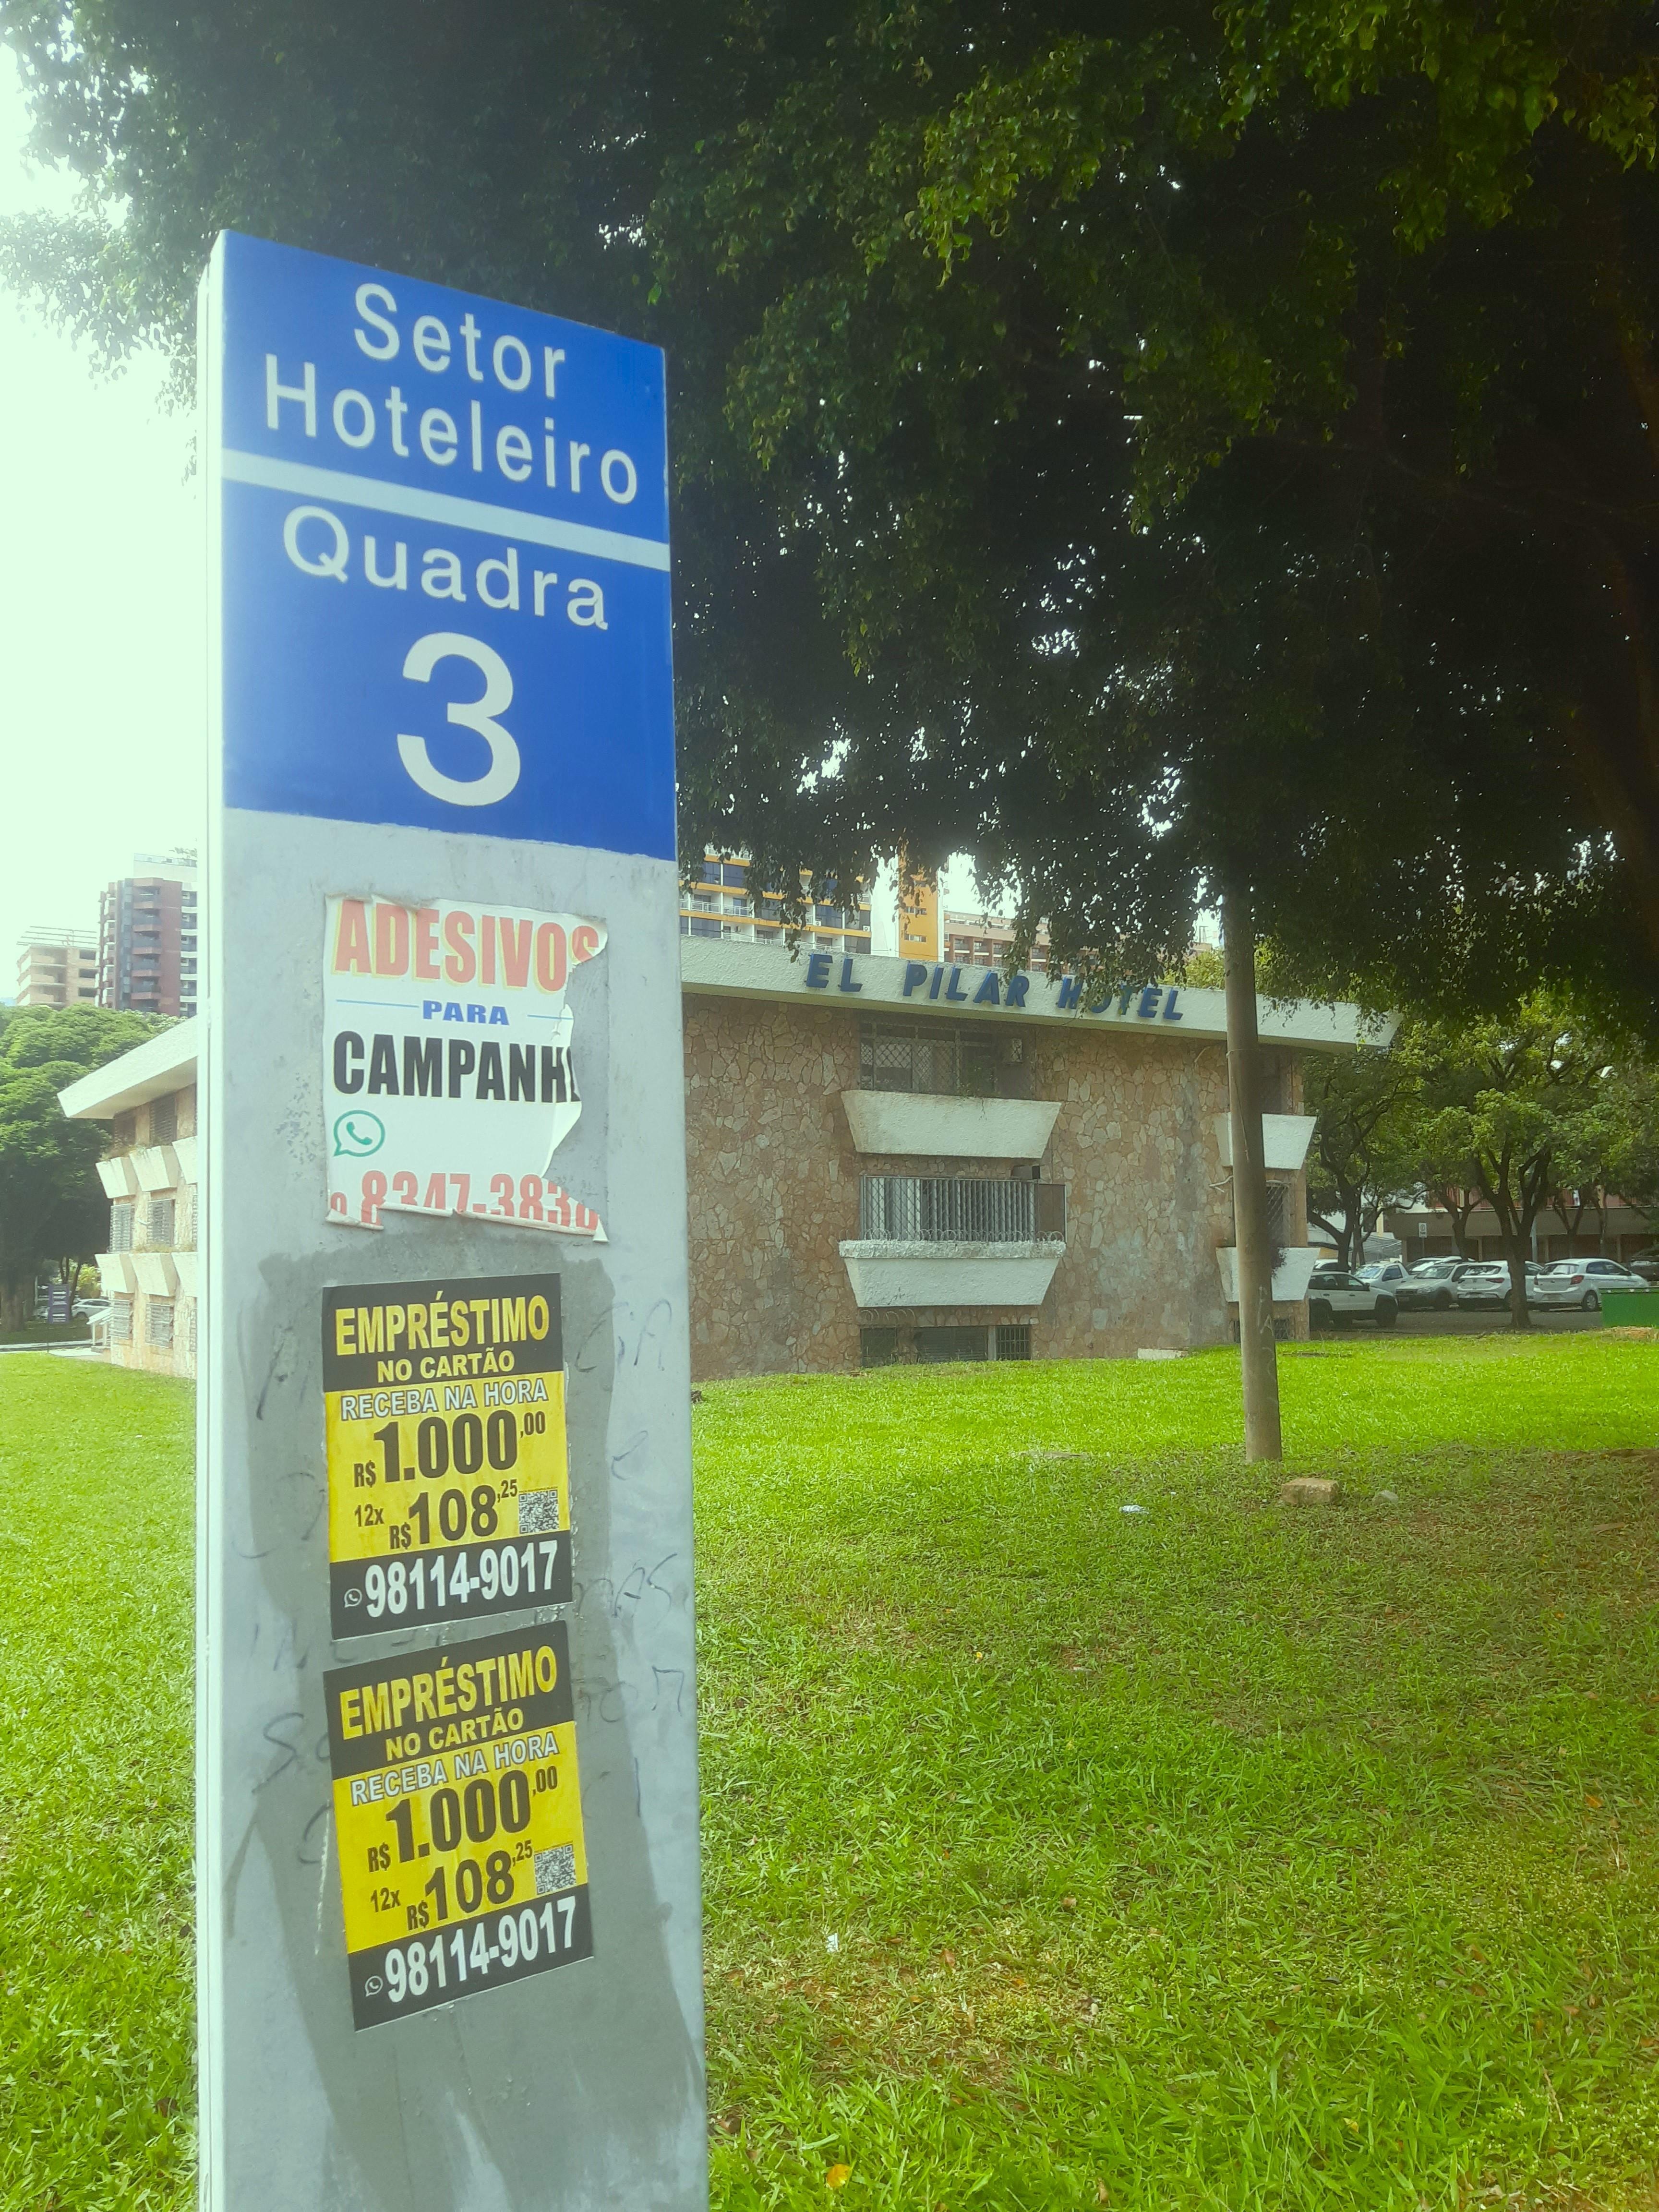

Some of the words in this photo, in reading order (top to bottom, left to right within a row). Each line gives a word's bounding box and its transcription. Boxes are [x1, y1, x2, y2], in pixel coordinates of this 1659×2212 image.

[354, 284, 565, 399] Setor
[266, 354, 637, 504] Hoteleiro
[283, 505, 608, 630] Quadra
[397, 632, 520, 806] 3
[422, 1000, 509, 1026] PARA
[805, 953, 863, 992] EL
[902, 961, 1030, 1008] PILAR
[336, 1290, 550, 1356] EMPRÉSTIMO
[341, 1389, 438, 1421] RECEBA
[445, 1384, 478, 1411] NA
[484, 1378, 549, 1407] HORA
[378, 1359, 412, 1383] NO
[420, 1346, 515, 1379] CARTÃO
[354, 1504, 385, 1527] 12x
[365, 1540, 558, 1618] 98114-9017
[340, 1646, 557, 1740] EMPRÉSTIMO
[350, 1759, 448, 1807] RECEBA
[454, 1749, 488, 1779] NA
[493, 1731, 560, 1770] HORA
[386, 1732, 421, 1761] NO
[429, 1707, 524, 1750] CARTÃO
[370, 1887, 401, 1913] 12x
[385, 1895, 576, 2003] 98114-9017
